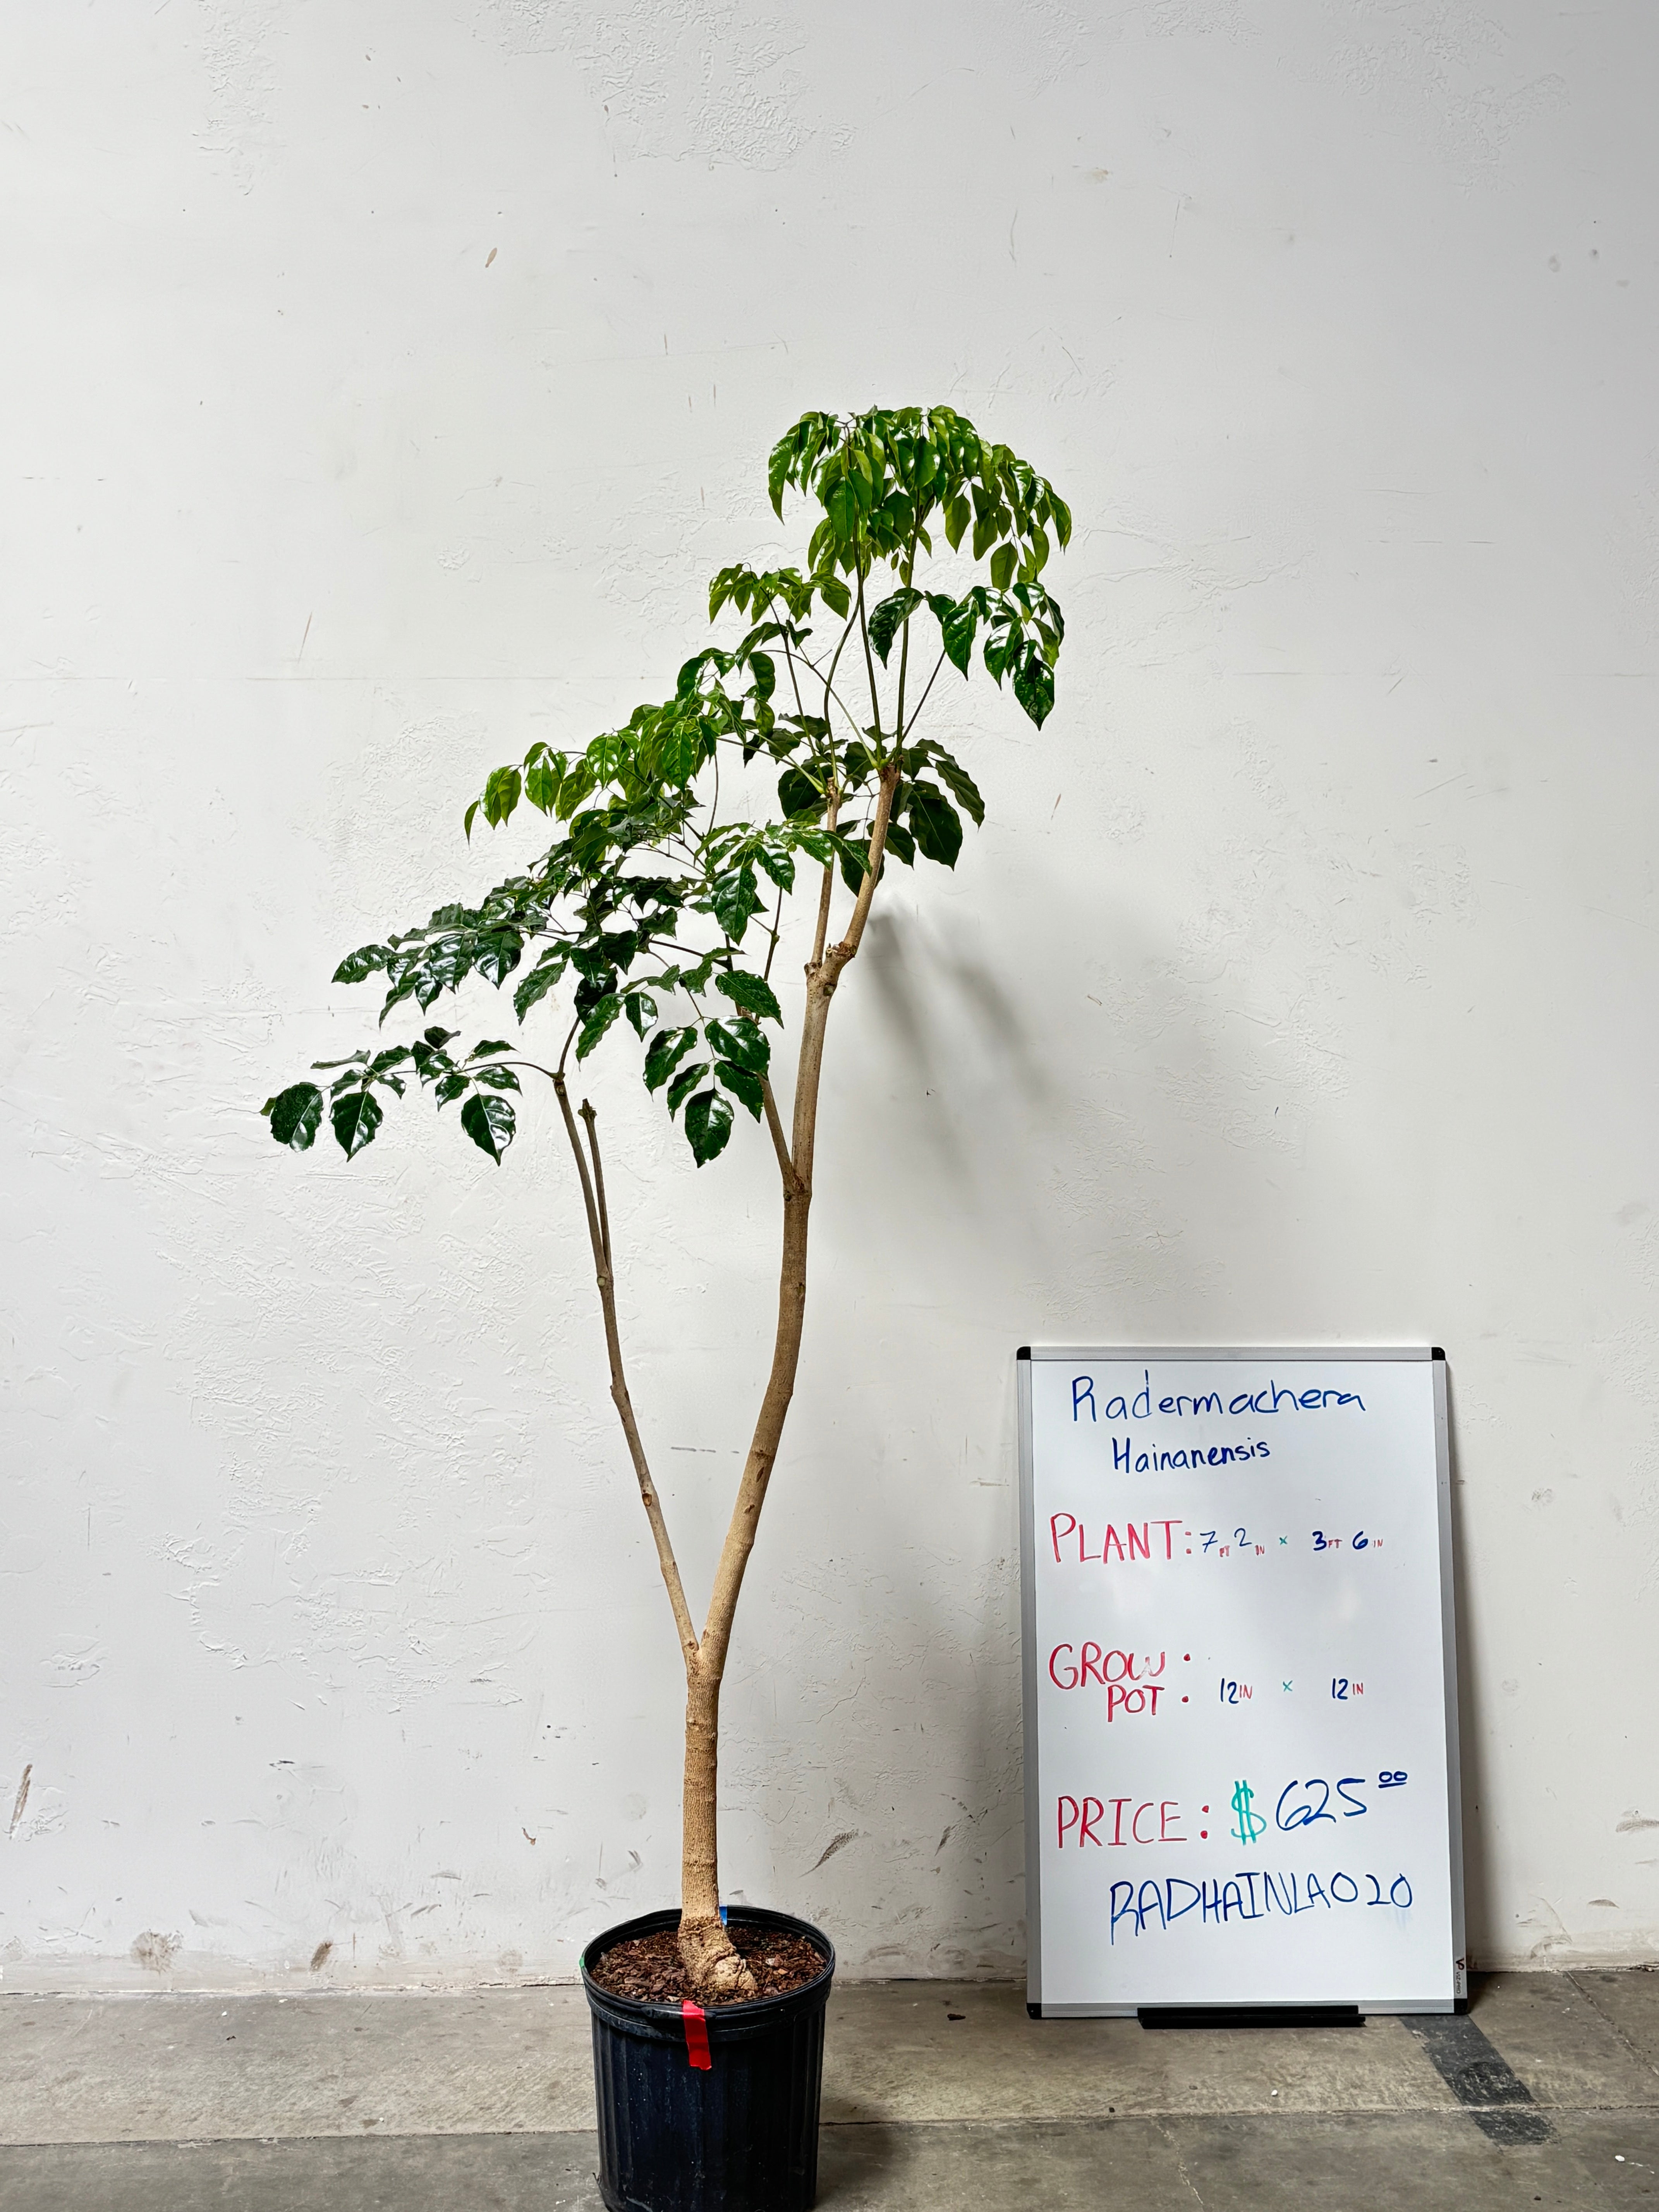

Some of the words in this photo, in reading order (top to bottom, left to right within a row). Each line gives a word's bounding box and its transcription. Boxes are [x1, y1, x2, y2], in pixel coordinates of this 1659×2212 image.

[1072, 1369, 1366, 1422] Radermachera
[1112, 1437, 1271, 1473] Hainanensis
[1049, 1512, 1192, 1565] PLANT:
[1049, 1642, 1165, 1690] GROW
